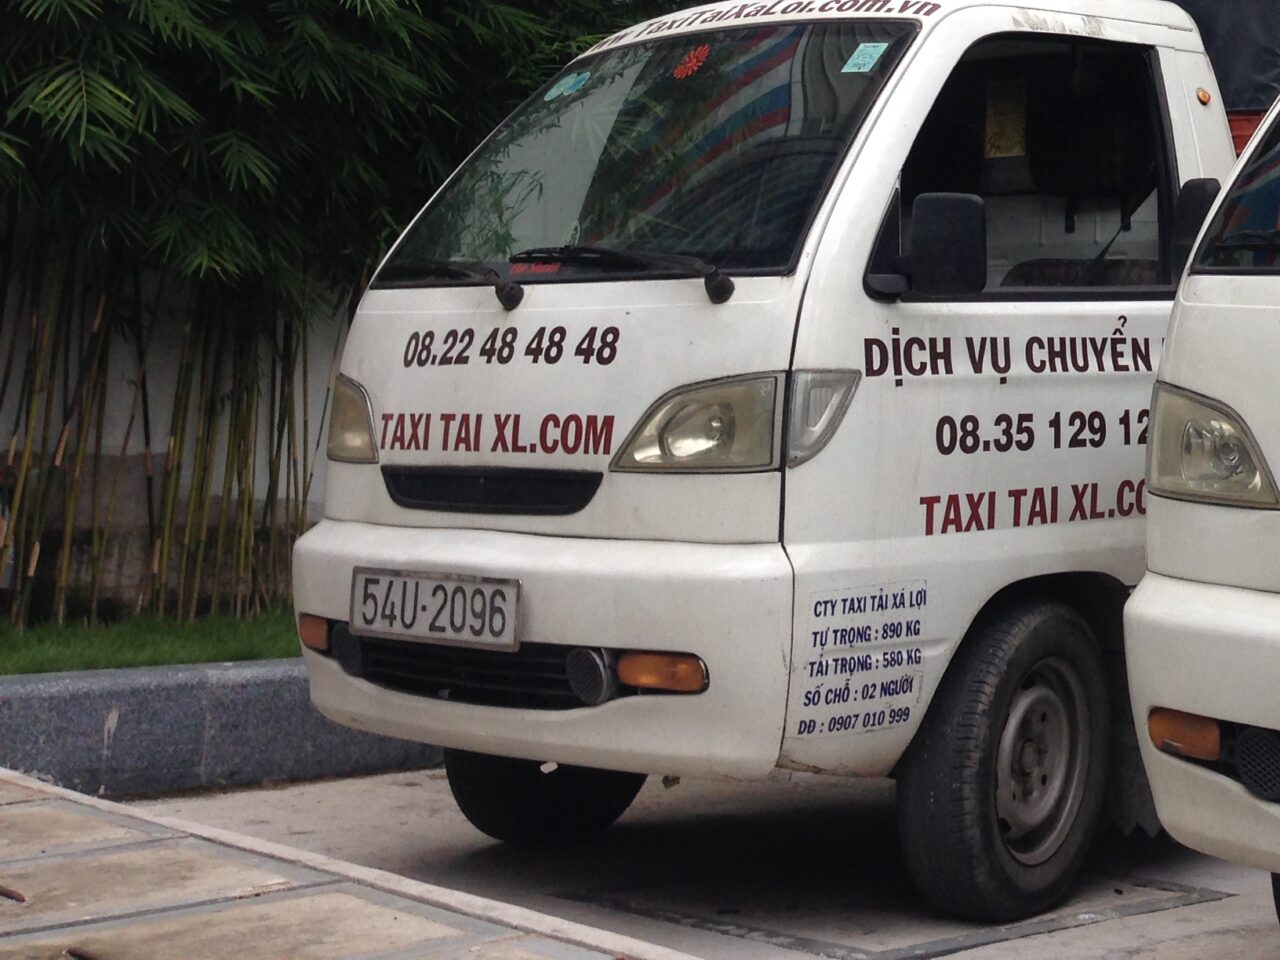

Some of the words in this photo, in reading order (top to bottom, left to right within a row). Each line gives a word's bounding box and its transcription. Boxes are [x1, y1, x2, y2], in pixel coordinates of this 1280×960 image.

[403, 328, 475, 368] 08.22
[479, 326, 518, 365] 48
[524, 325, 567, 365] 48
[574, 326, 620, 366] 48
[965, 336, 1012, 385] VỤ
[1024, 315, 1153, 373] CHUYỂN
[380, 412, 432, 451] TAXI
[440, 413, 483, 453] TAI
[490, 413, 615, 455] XL.COM
[935, 413, 1035, 456] 08.35
[1048, 410, 1107, 449] 129
[1118, 408, 1150, 446] 12
[919, 491, 997, 536] TAXI
[1007, 485, 1060, 528] TAI
[1068, 478, 1147, 522] XL.CO
[813, 598, 838, 618] CTY
[841, 596, 867, 615] TAXI
[870, 588, 889, 613] TẢI
[891, 587, 906, 610] XÁ
[832, 625, 872, 648] TRỌNG
[881, 622, 903, 640] 890
[905, 619, 921, 638] KG
[809, 653, 829, 678] TẢI
[832, 653, 873, 676] TRỌNG
[882, 650, 904, 669] 580
[906, 647, 922, 666] KG
[803, 683, 824, 707] SỐ
[861, 683, 877, 700] 02
[827, 714, 860, 732] 0907
[862, 710, 886, 729] 010
[888, 706, 911, 725] 999
